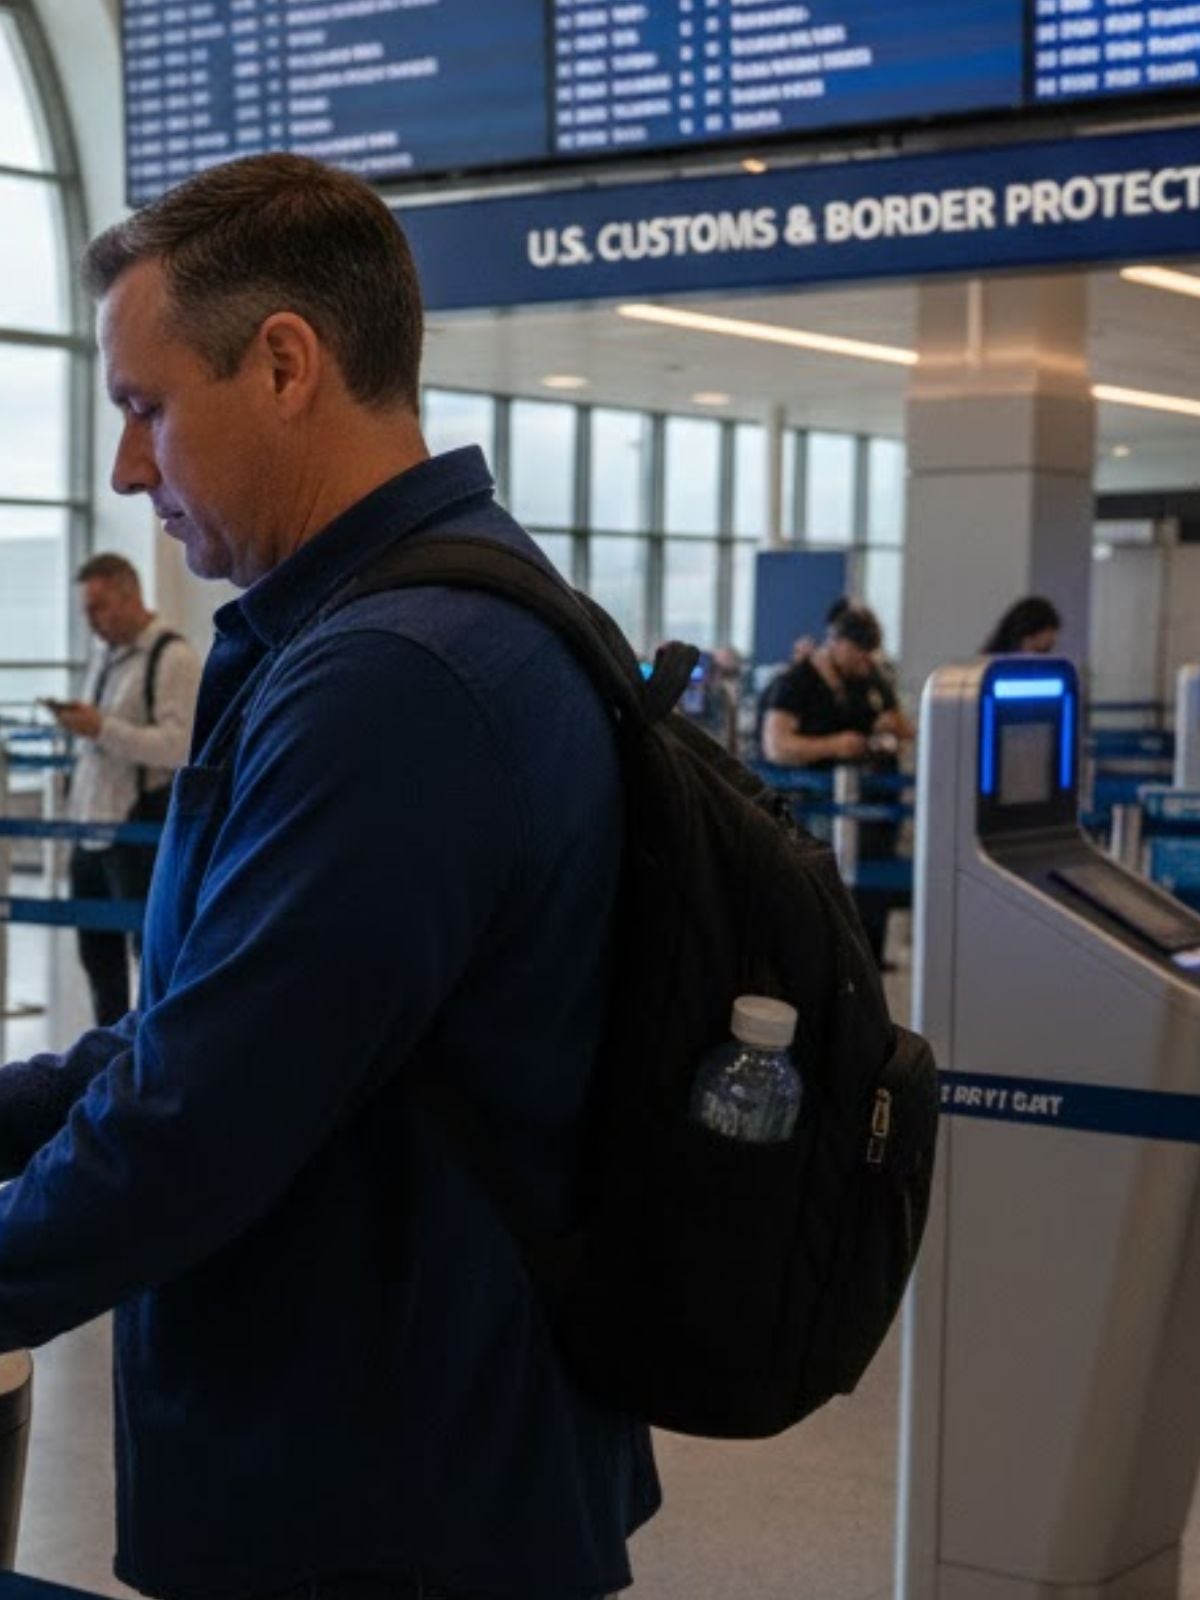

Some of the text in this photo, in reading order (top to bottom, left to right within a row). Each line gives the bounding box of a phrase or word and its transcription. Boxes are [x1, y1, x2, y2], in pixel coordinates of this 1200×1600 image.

[527, 165, 1200, 268] U.S. CUSTOMS & BORDER PROTECT
